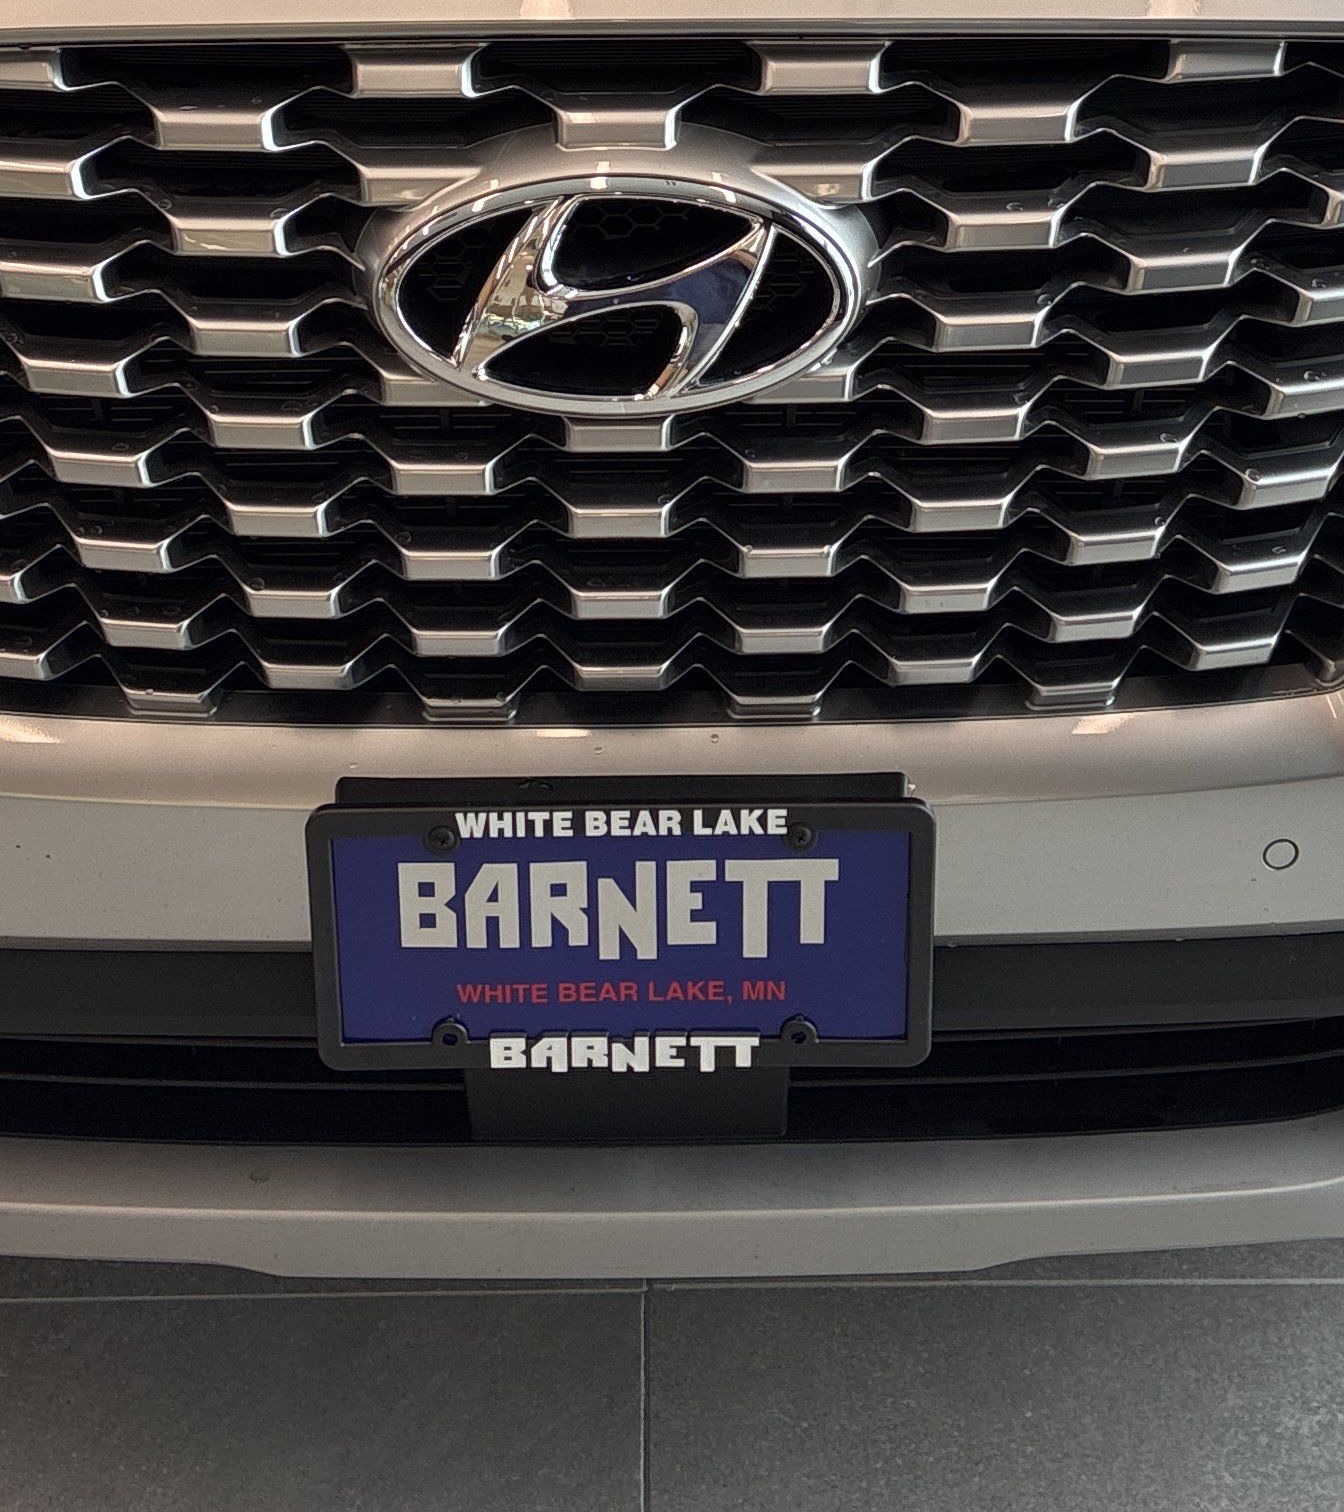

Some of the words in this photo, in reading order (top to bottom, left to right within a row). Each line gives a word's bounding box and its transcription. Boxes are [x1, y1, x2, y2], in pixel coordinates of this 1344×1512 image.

[454, 811, 574, 838] WHITE
[585, 809, 682, 837] BEAR
[693, 808, 788, 836] LAKE
[397, 858, 839, 960] BARNETT
[457, 983, 548, 1004] WHITE
[558, 982, 638, 1003] BEAR
[648, 981, 734, 1005] LAKE,
[742, 980, 786, 1001] MN
[489, 1036, 760, 1073] BARNETT
